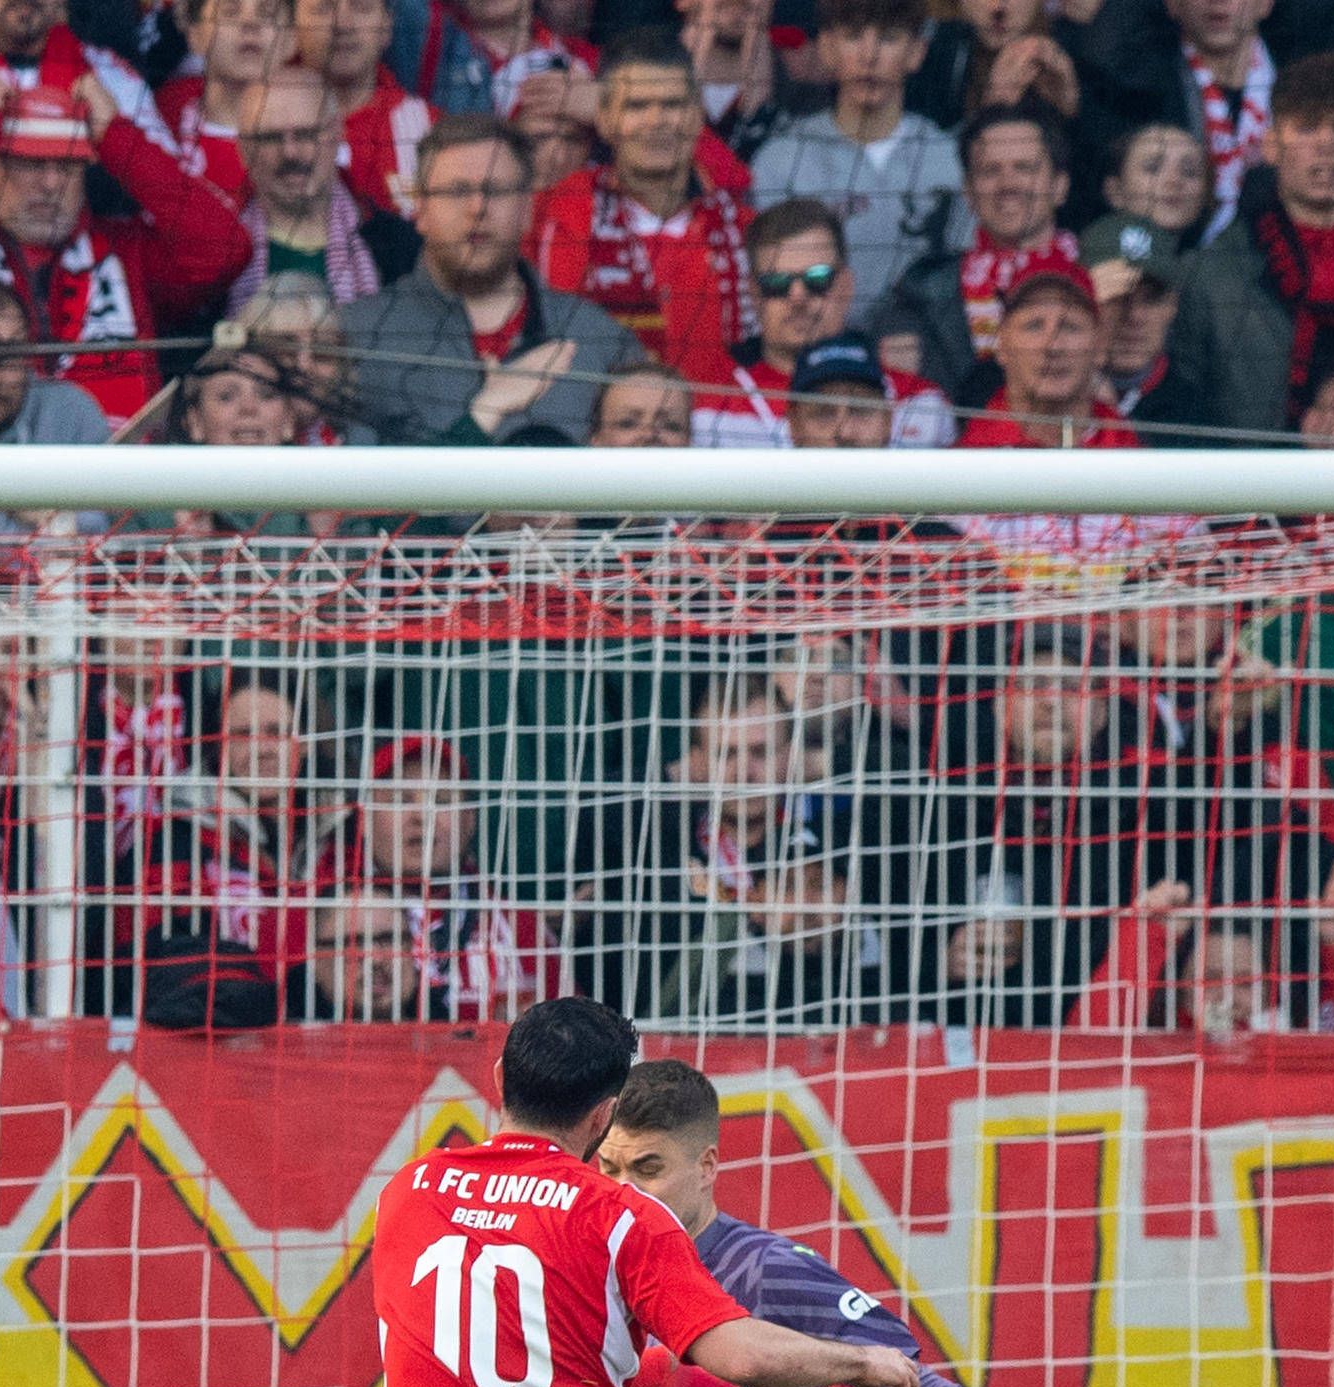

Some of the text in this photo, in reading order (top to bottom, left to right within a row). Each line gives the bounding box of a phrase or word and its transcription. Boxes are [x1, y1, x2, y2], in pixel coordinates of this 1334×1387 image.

[412, 1163, 580, 1211] 1. FC UNION
[451, 1206, 518, 1232] BERLIN
